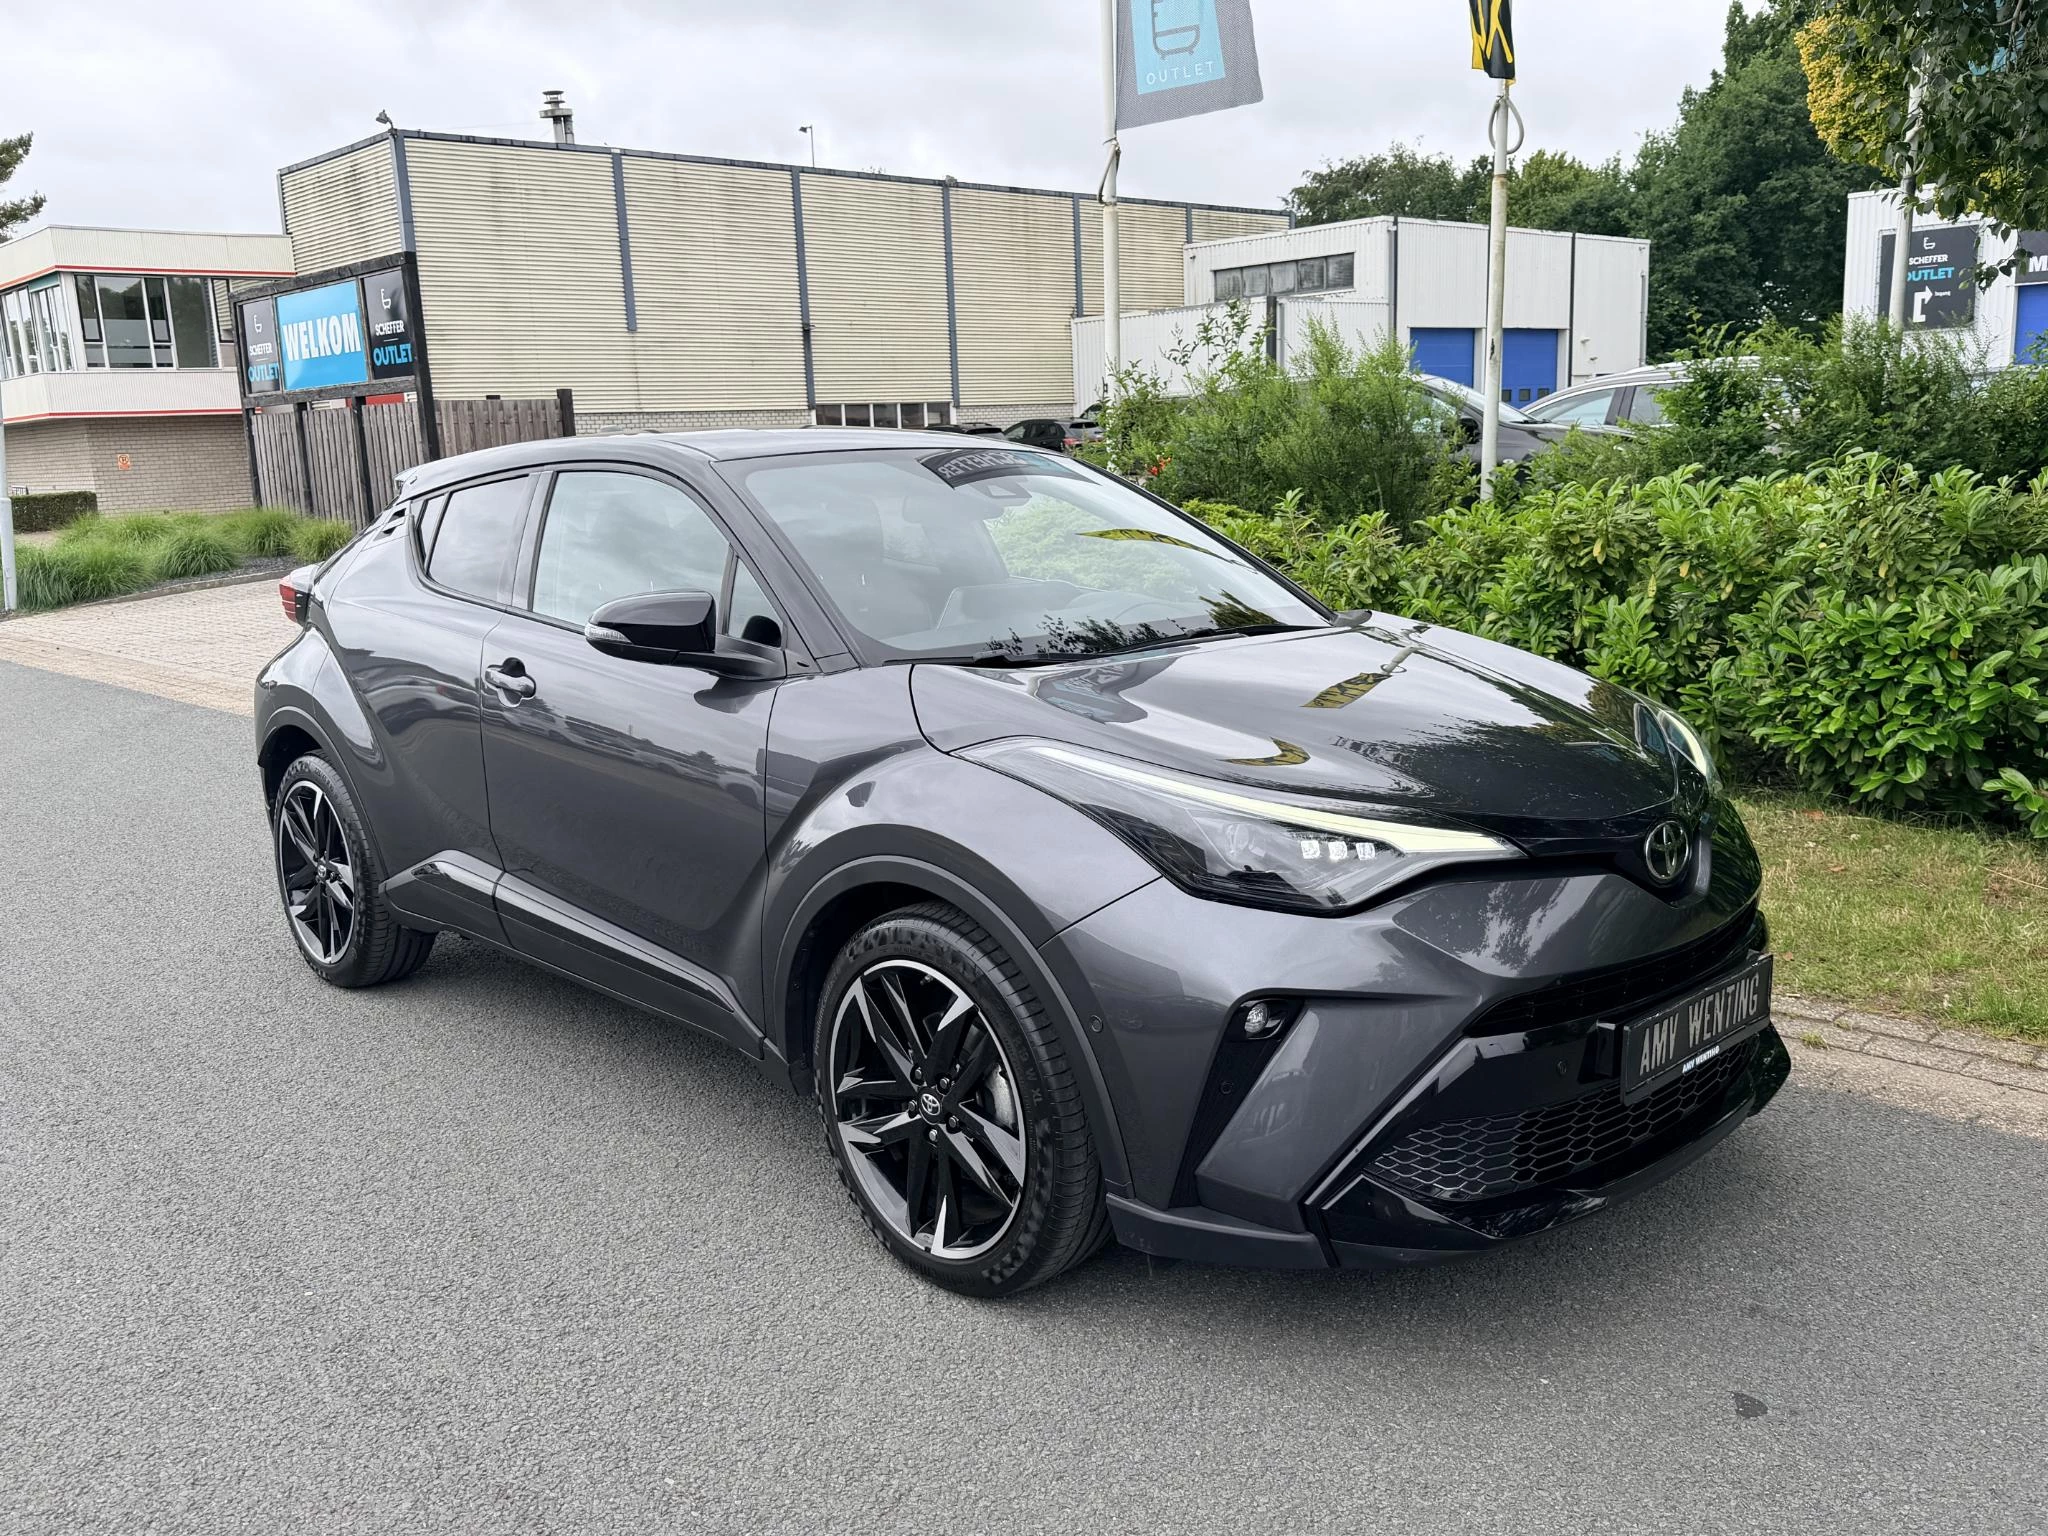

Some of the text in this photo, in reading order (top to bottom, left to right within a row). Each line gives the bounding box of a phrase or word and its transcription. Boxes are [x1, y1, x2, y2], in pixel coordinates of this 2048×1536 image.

[1145, 60, 1215, 86] OUTLET
[1908, 253, 1949, 266] SCHEFFER
[2028, 255, 2048, 273] M
[283, 312, 362, 362] WELKOM
[374, 319, 405, 336] SCHEFFER
[249, 342, 272, 357] SCHEFFER
[373, 343, 413, 366] OUTLET
[248, 362, 279, 383] OUTLET
[1639, 972, 1760, 1076] AMY WENTING
